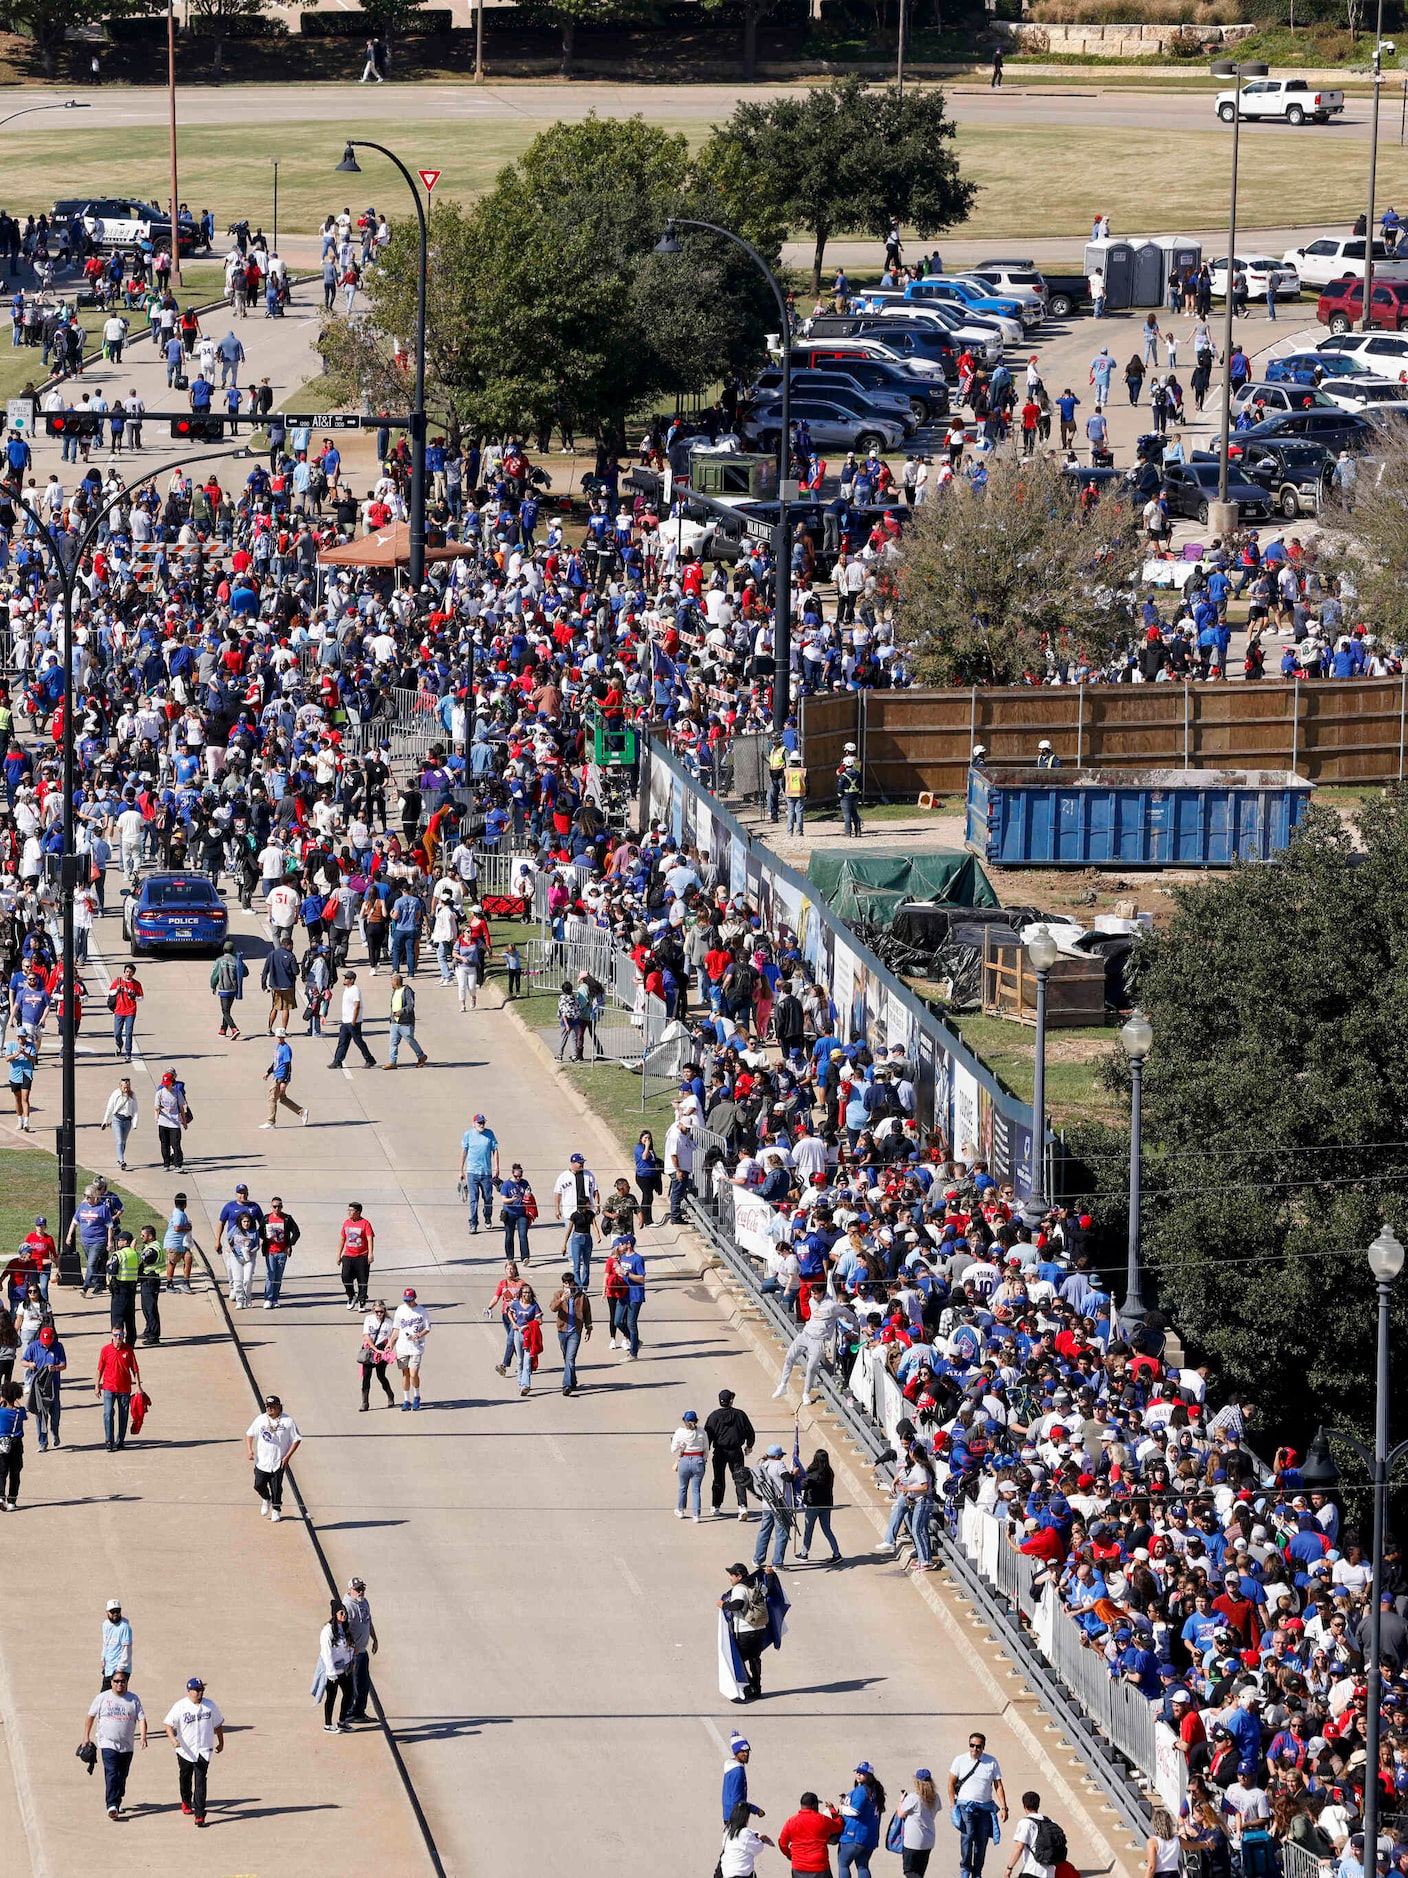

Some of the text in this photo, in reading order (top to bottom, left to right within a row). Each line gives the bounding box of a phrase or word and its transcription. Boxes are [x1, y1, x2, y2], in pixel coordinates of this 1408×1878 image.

[312, 416, 331, 427] AT&T
[979, 1280, 993, 1291] 10
[183, 1709, 212, 1722] Rangers
